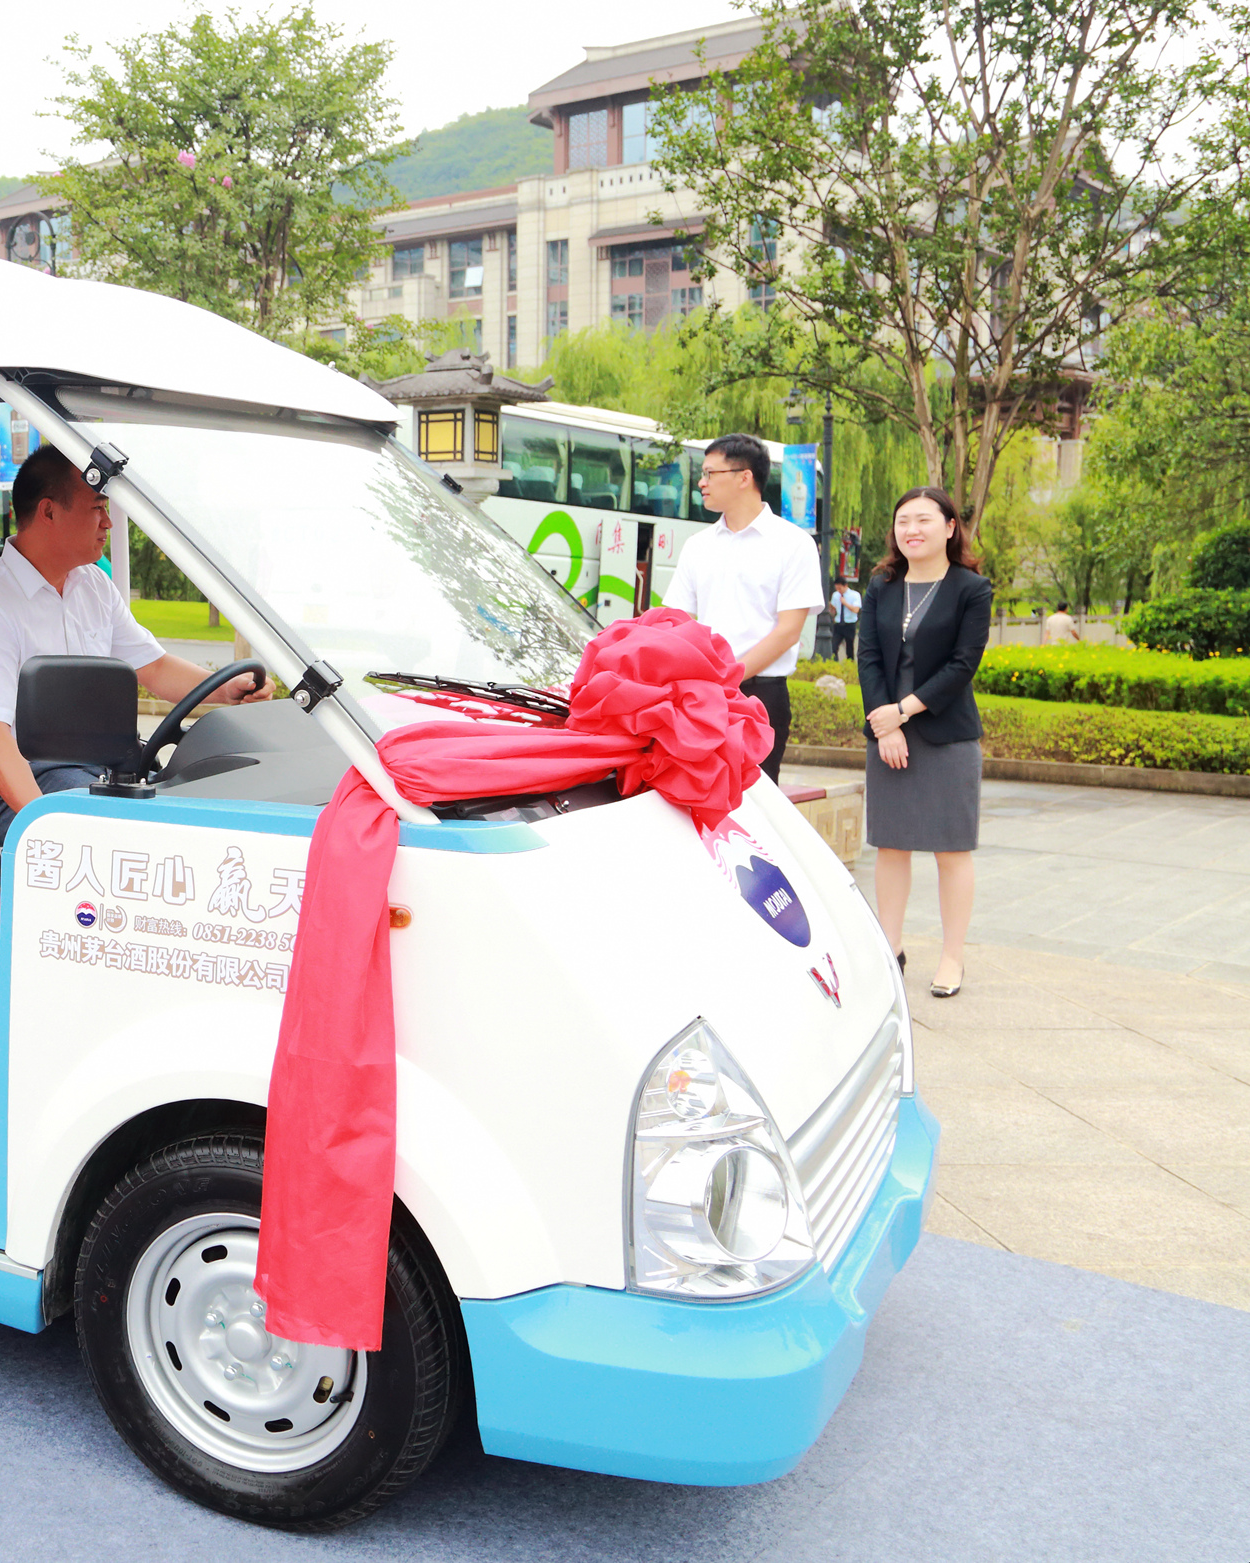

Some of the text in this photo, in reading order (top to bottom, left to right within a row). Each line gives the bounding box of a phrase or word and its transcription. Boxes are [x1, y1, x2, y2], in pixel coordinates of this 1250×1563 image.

[26, 839, 196, 906] 酱人匠心
[39, 930, 291, 994] 贵州茅台酒股份有限公司
